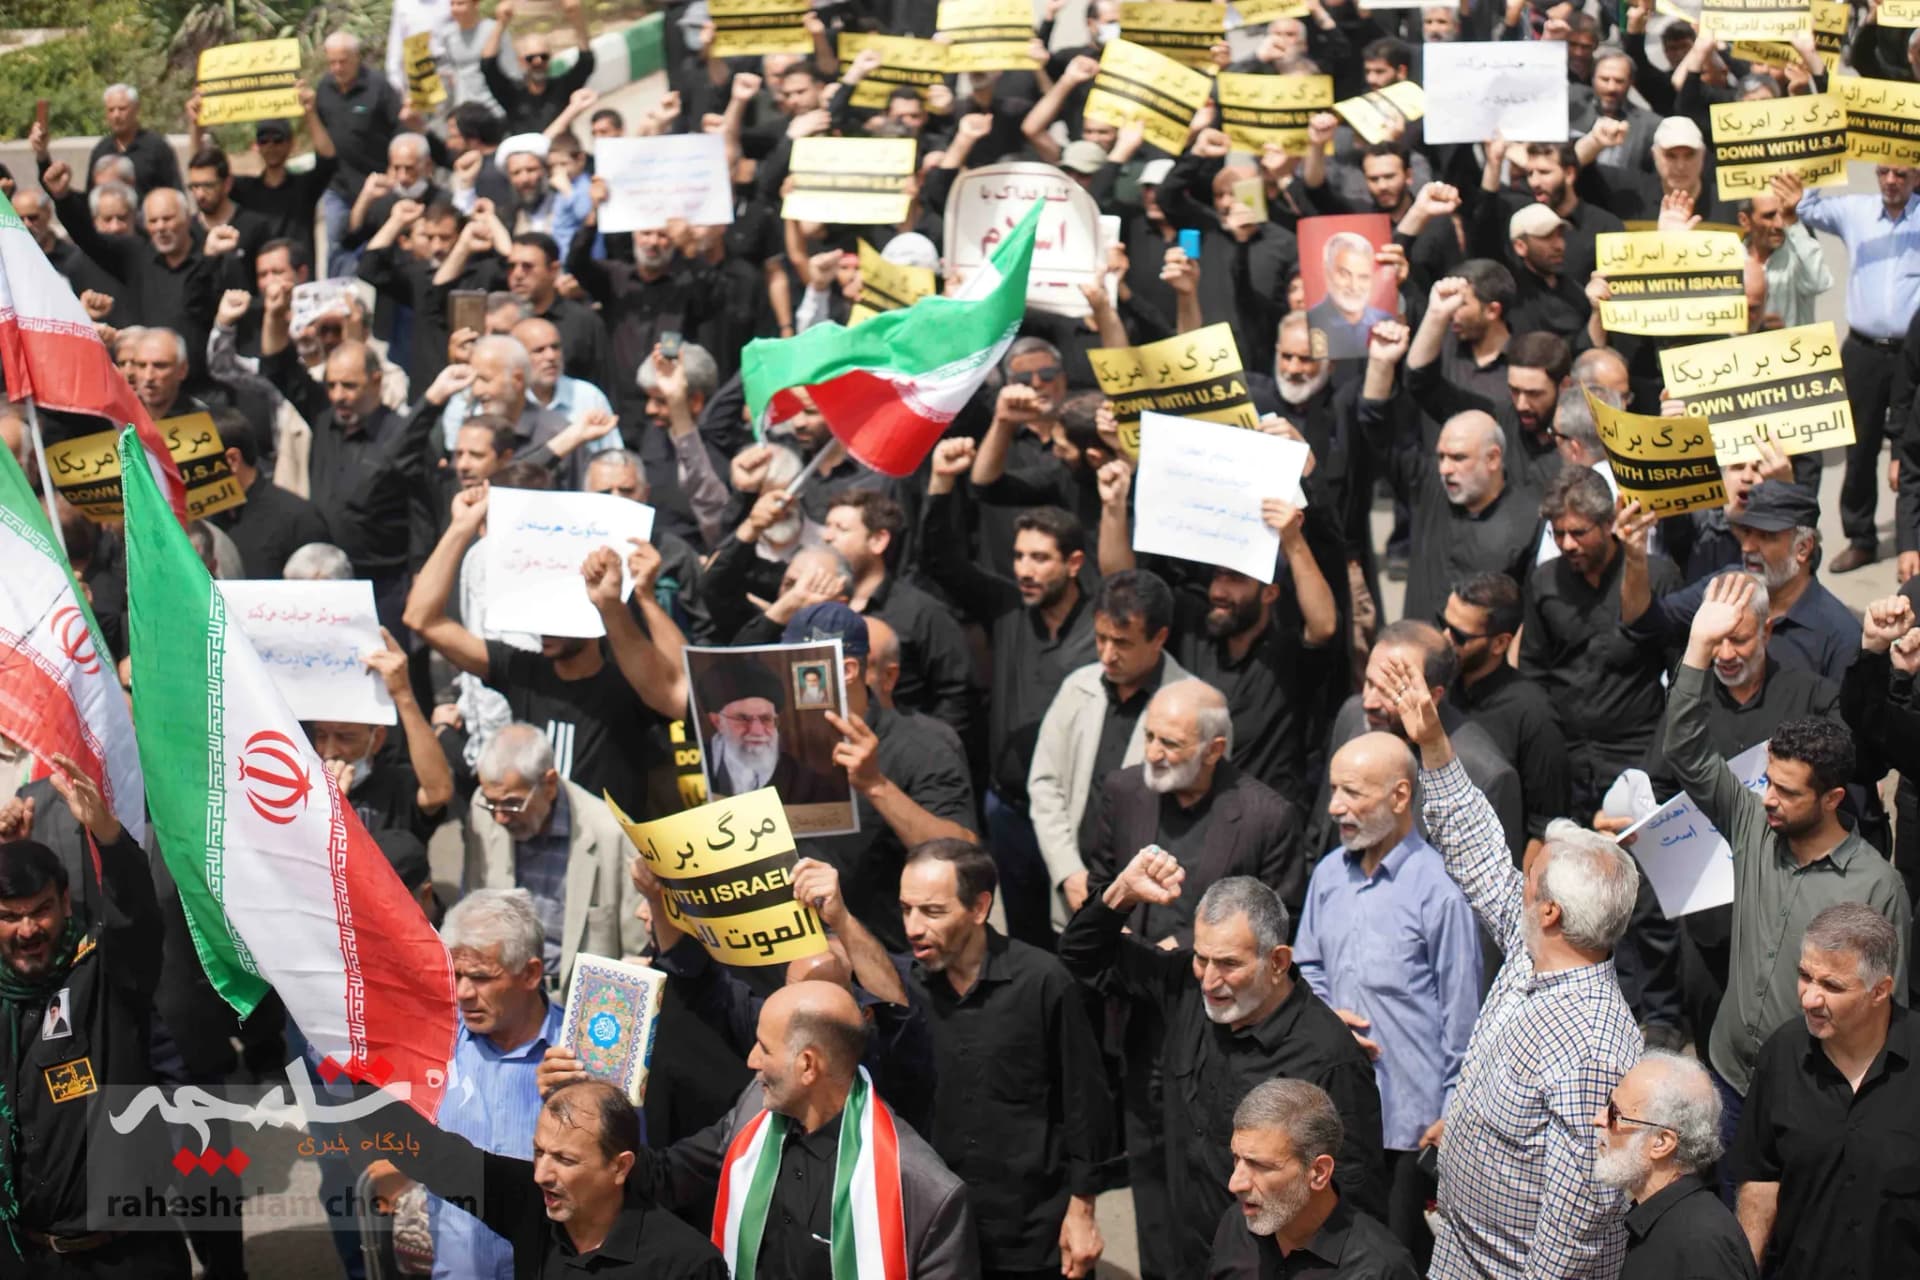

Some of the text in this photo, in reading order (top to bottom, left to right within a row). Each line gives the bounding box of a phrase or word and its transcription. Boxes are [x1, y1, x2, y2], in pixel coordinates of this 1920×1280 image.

[1717, 103, 1841, 137] مرگ بر امریکا
[1867, 118, 1900, 133] WITH
[1716, 134, 1845, 161] DOWN WITH U.S.A
[1673, 250, 1688, 267] بر
[1696, 239, 1736, 263] مرگ
[1608, 274, 1744, 296] OWN WITH ISRAEL
[1686, 302, 1745, 328] الموت
[1157, 362, 1175, 384] بر
[1178, 346, 1230, 374] مرگ
[1671, 338, 1833, 388] مرگ بر امریکا
[1157, 390, 1197, 411] WITH
[1196, 380, 1247, 405] U.S.A
[1686, 376, 1845, 418] OWN WITH U.S.A
[1651, 424, 1705, 455] مرگ
[1775, 409, 1846, 444] الموت
[1625, 433, 1645, 456] بر
[53, 442, 122, 479] امریکا
[1611, 457, 1717, 484] WITH ISRAEL
[64, 484, 120, 502] DOWN
[188, 481, 236, 516] المو
[1649, 484, 1724, 512] الموت
[1647, 802, 1691, 830] اهانت
[706, 810, 777, 852] مرگ
[1660, 824, 1698, 847] است
[673, 841, 699, 871] بر
[725, 906, 817, 957] الموت
